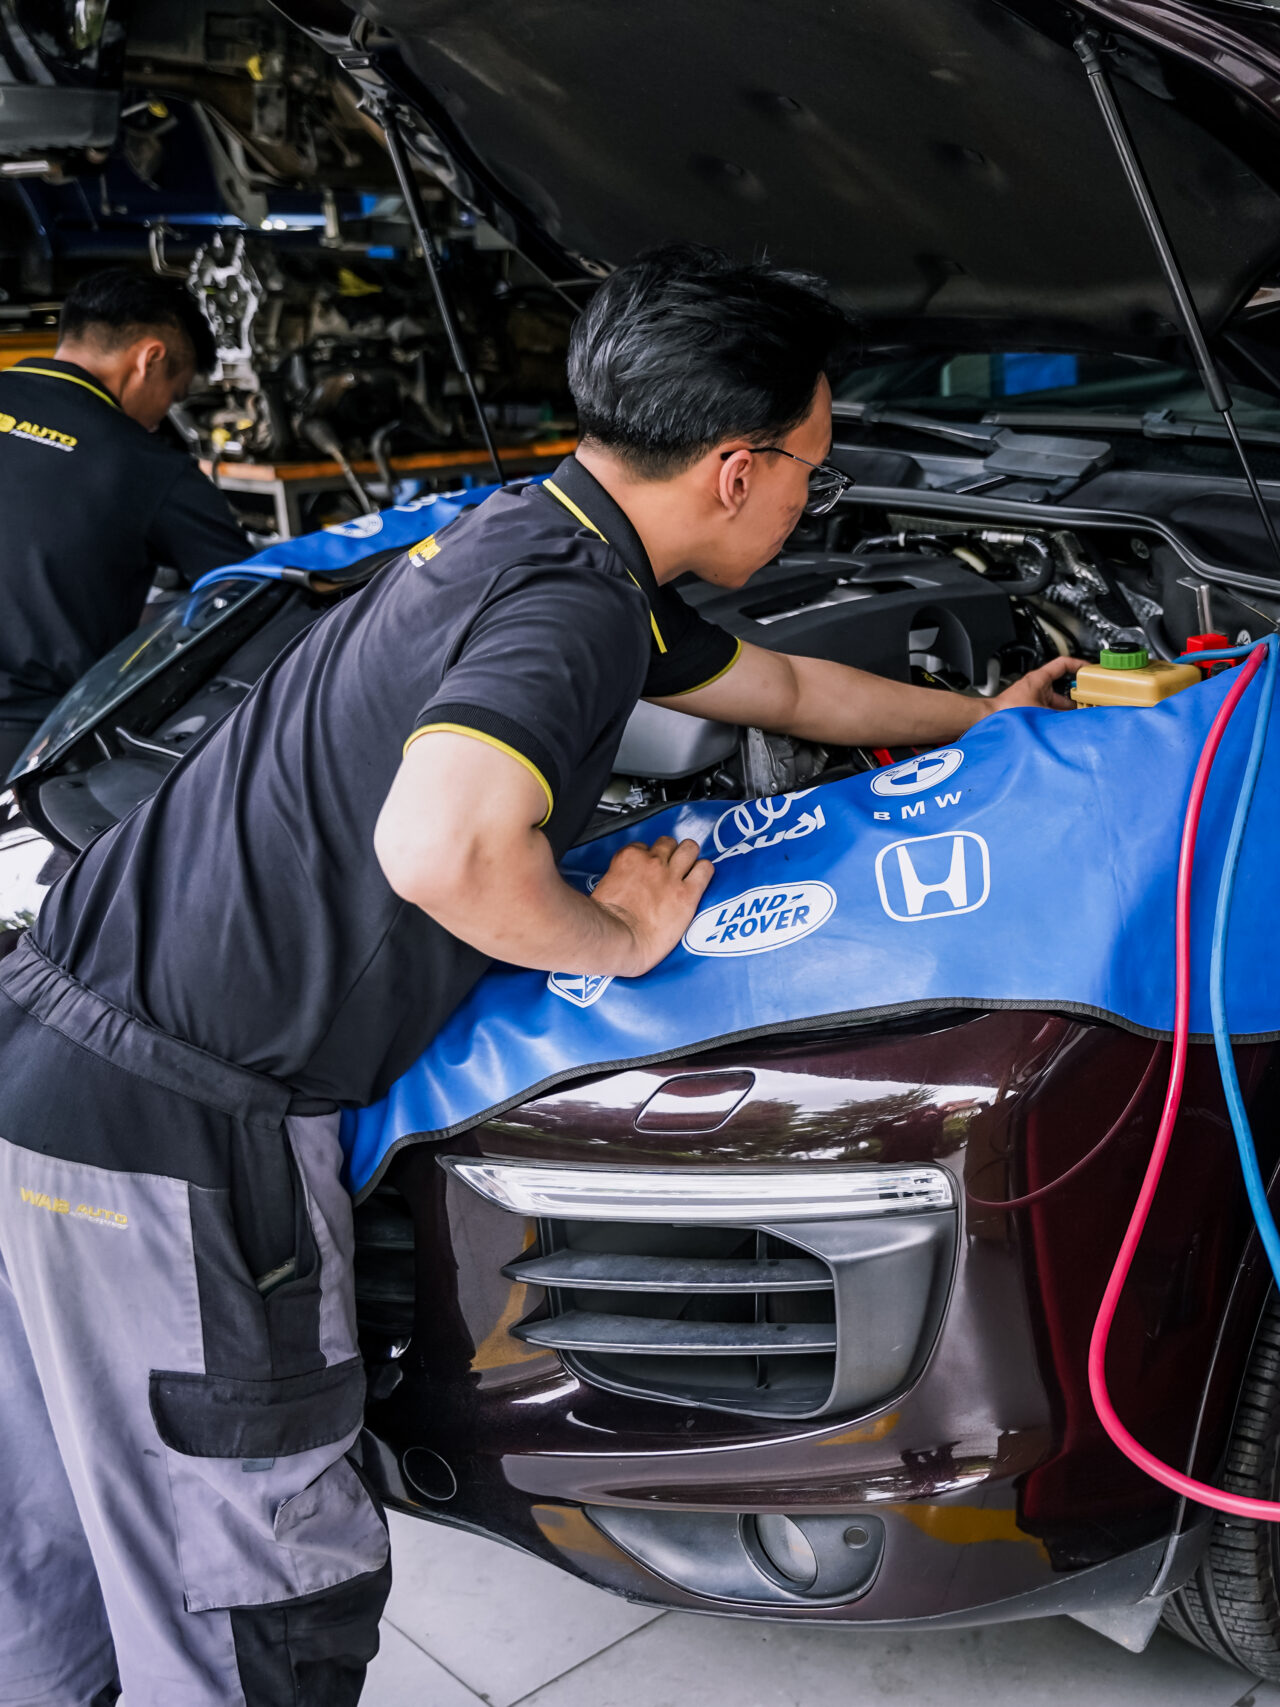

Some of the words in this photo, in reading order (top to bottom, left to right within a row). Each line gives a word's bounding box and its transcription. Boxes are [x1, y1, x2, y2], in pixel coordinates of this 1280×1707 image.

[16, 420, 78, 447] AUTO
[873, 790, 962, 820] BMW
[711, 804, 827, 864] Audi
[20, 1186, 70, 1216] WAB
[76, 1203, 128, 1225] AUTO
